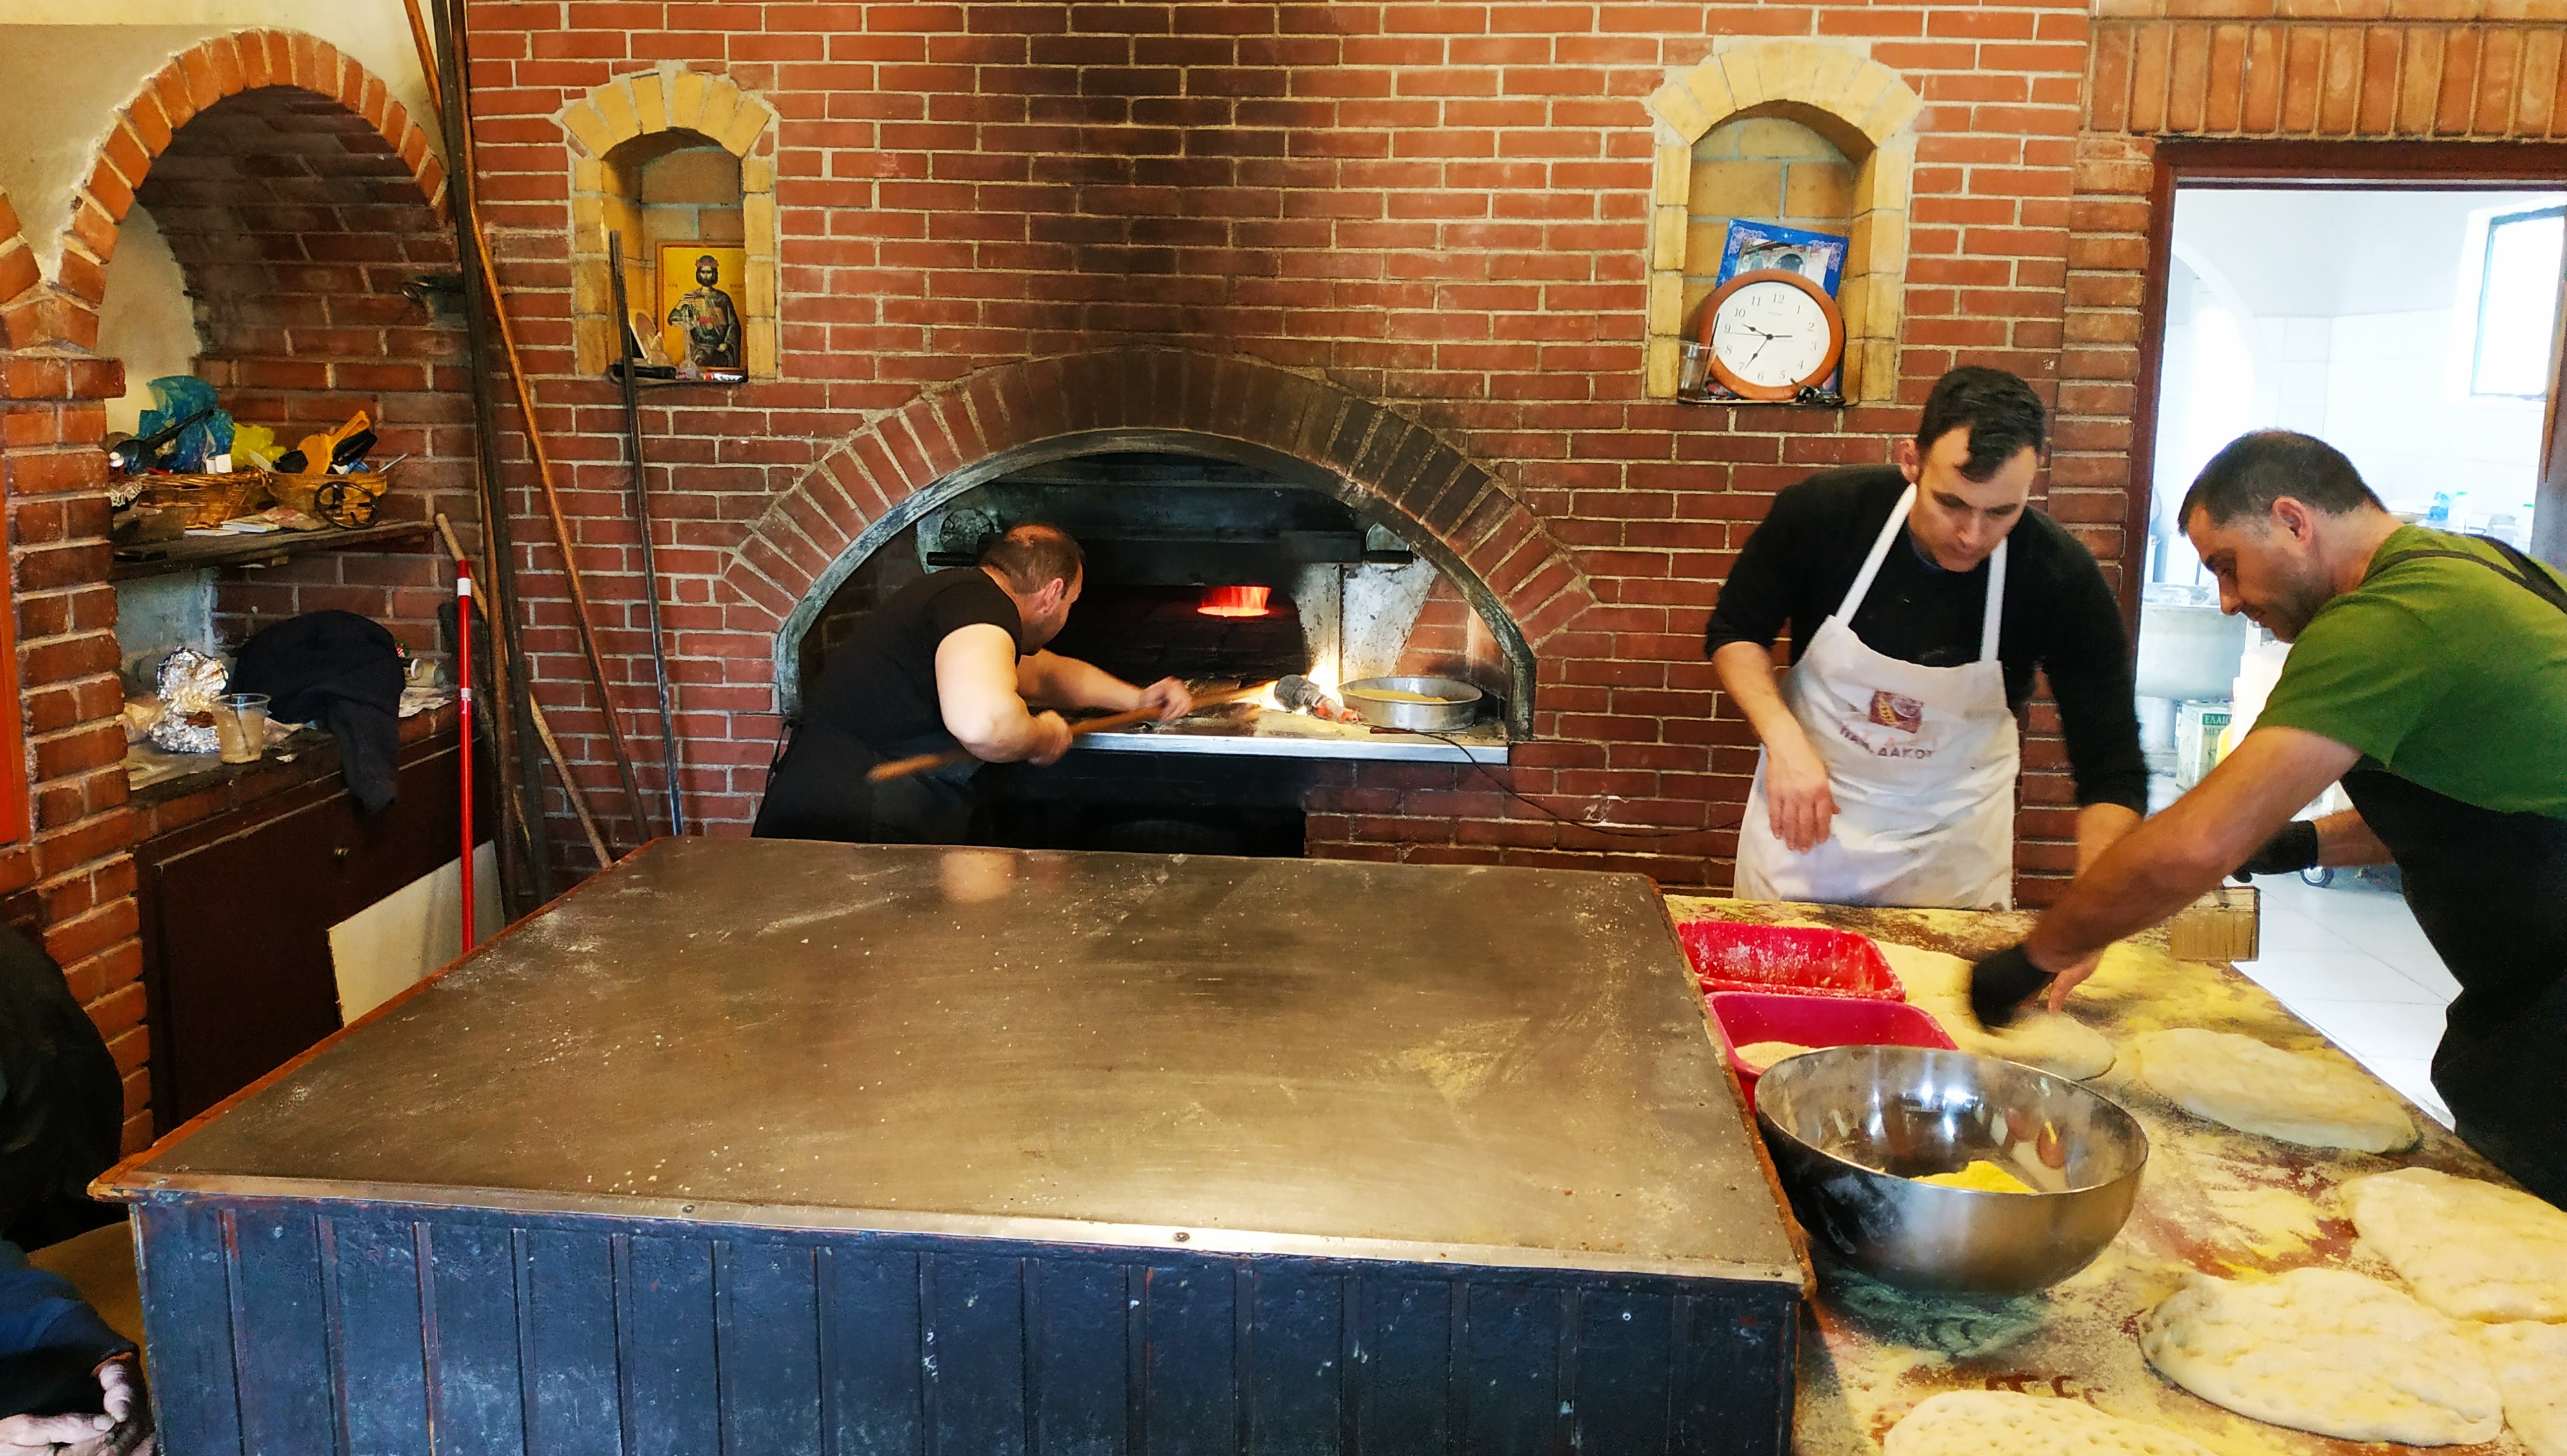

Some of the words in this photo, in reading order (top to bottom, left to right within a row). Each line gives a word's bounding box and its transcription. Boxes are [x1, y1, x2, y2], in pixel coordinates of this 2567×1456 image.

[1752, 296, 1761, 306] 11
[1773, 293, 1785, 304] 12
[1734, 308, 1746, 318] 10
[1724, 324, 1731, 334] 9
[1807, 323, 1815, 332] 2
[1725, 345, 1733, 355] 8
[1810, 342, 1817, 352] 3
[1739, 362, 1745, 372] 7
[1797, 360, 1804, 370] 4
[1757, 371, 1764, 381] 6
[1779, 370, 1786, 380] 5
